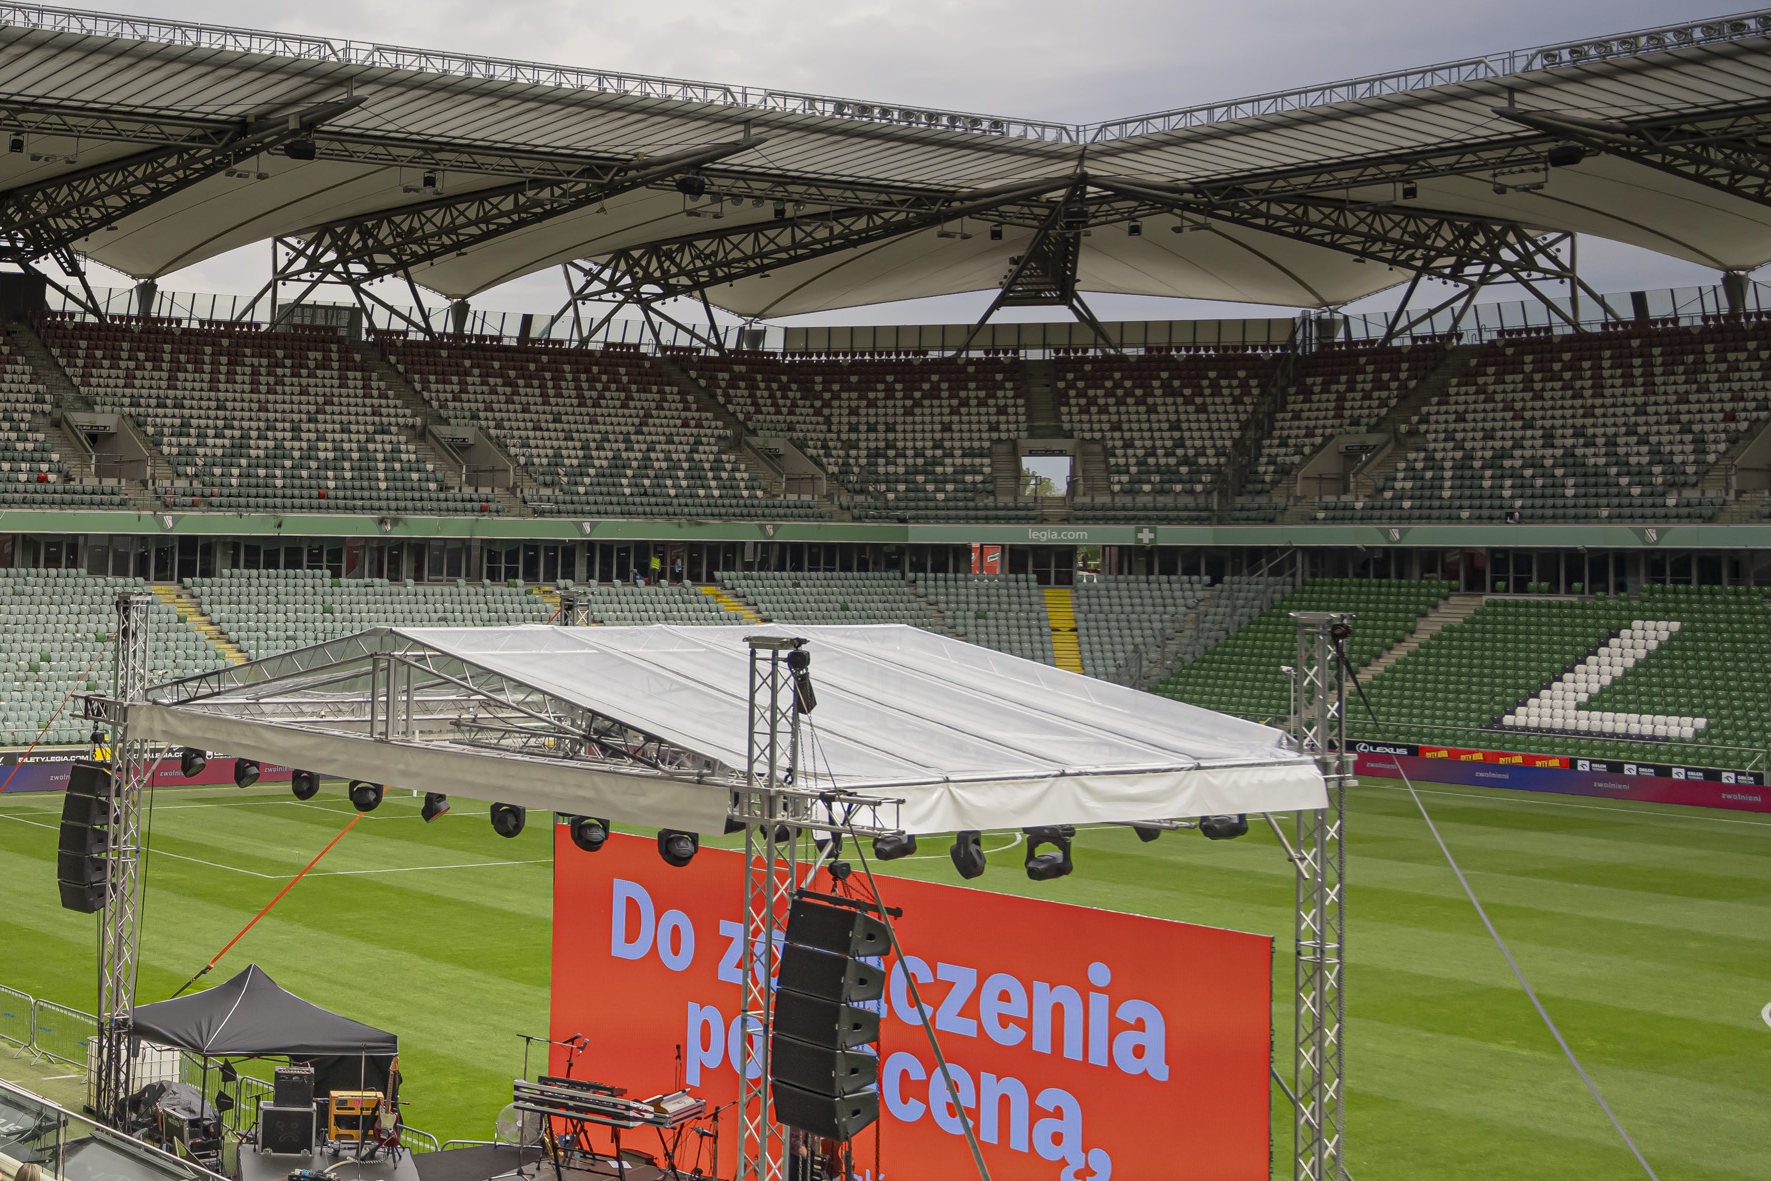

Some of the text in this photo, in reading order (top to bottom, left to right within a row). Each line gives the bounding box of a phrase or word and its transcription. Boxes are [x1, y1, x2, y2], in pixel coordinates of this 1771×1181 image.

[1028, 528, 1088, 542] legia.com
[1370, 746, 1408, 755] LEXUS
[1593, 781, 1630, 790] zwolnieni
[1721, 793, 1762, 802] zwolnieni
[611, 878, 695, 971] Do
